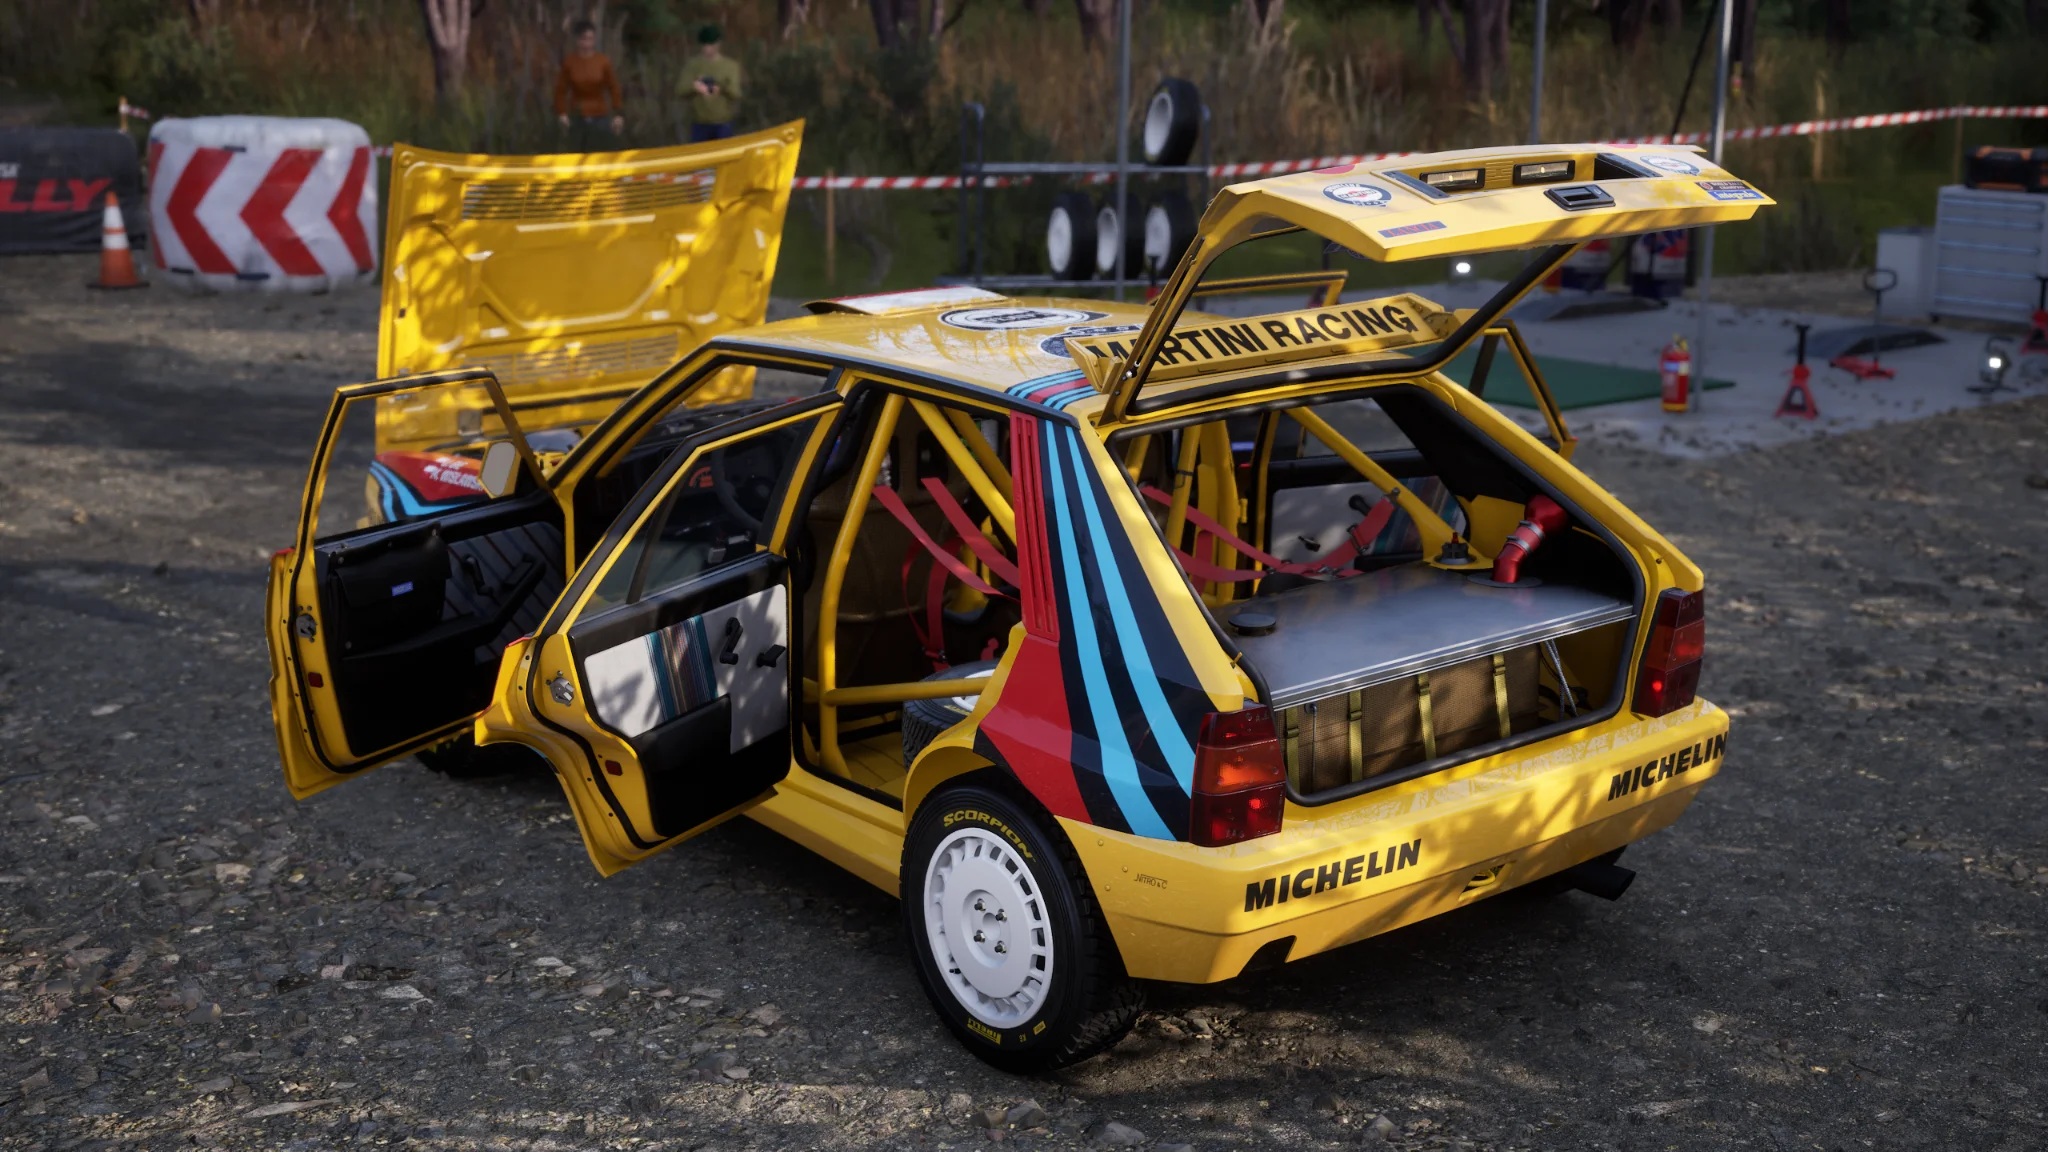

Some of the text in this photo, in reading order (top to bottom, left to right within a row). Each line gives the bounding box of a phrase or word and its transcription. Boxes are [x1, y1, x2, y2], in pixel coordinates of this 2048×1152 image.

[1260, 305, 1418, 347] RACING
[1607, 731, 1728, 802] MICHELIN
[944, 810, 1033, 858] SCORPION
[1244, 838, 1422, 913] MICHELIN
[966, 1017, 1002, 1046] PIRELLI
